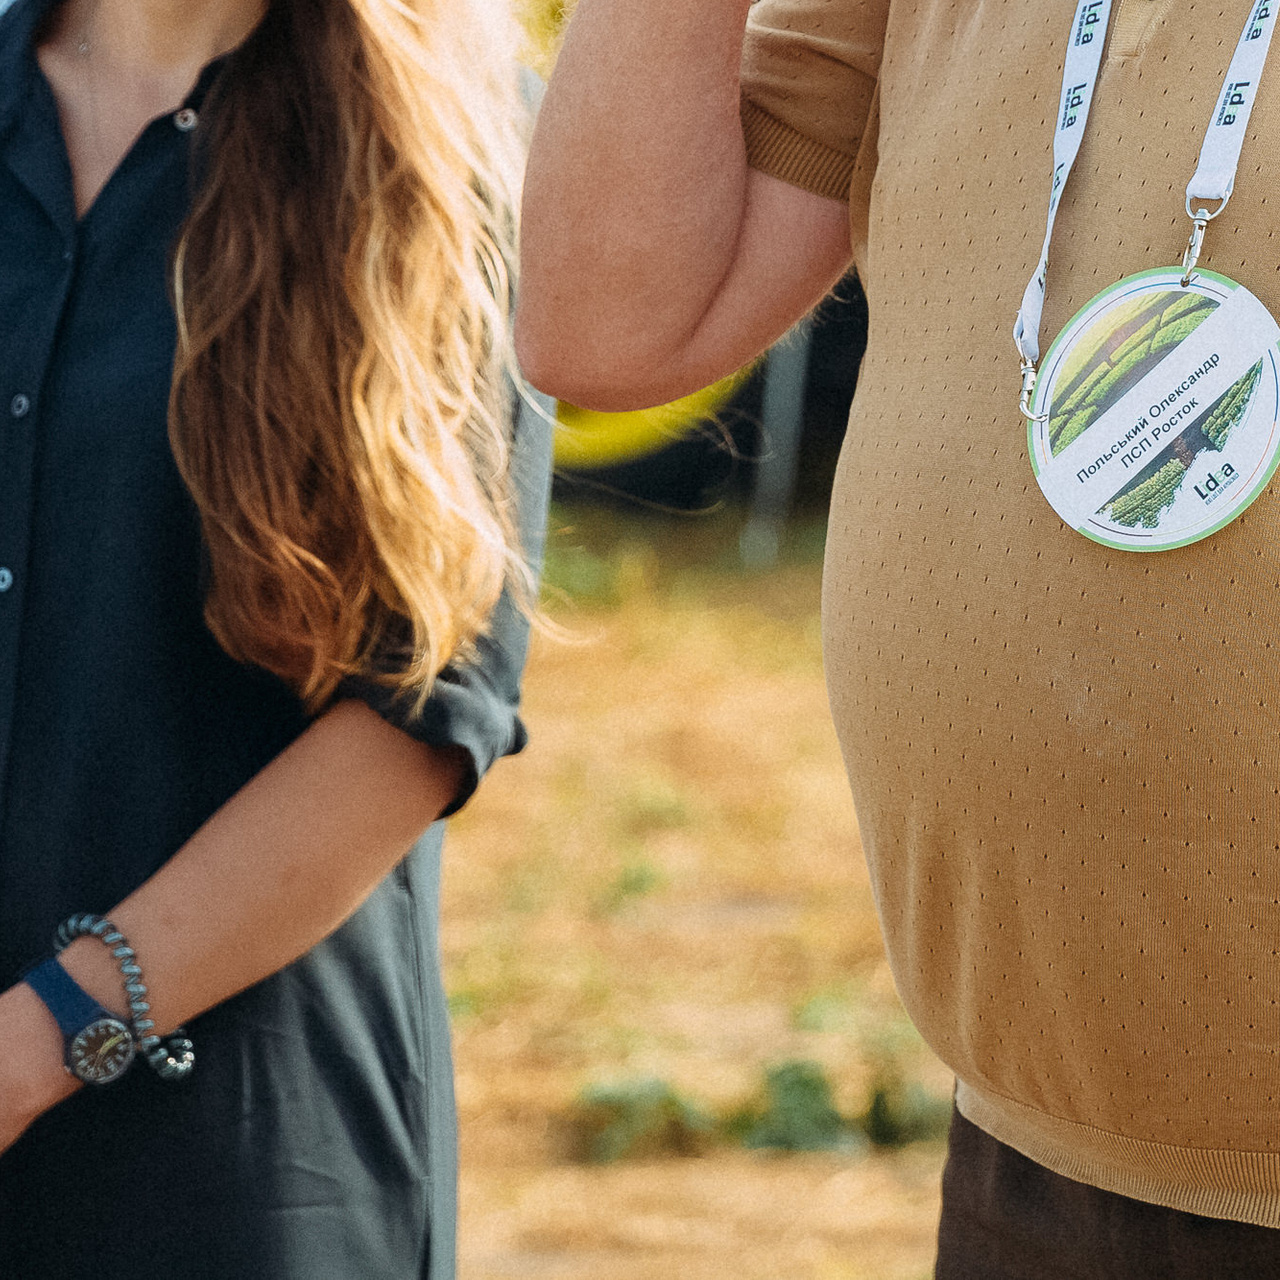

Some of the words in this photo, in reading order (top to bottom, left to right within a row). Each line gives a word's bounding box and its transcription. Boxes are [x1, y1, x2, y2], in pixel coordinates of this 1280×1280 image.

[1076, 417, 1149, 484] Польський
[1148, 351, 1221, 419] Олександр
[1119, 438, 1153, 469] ПСП
[1151, 396, 1199, 441] Росток
[1194, 462, 1235, 501] Lidea
